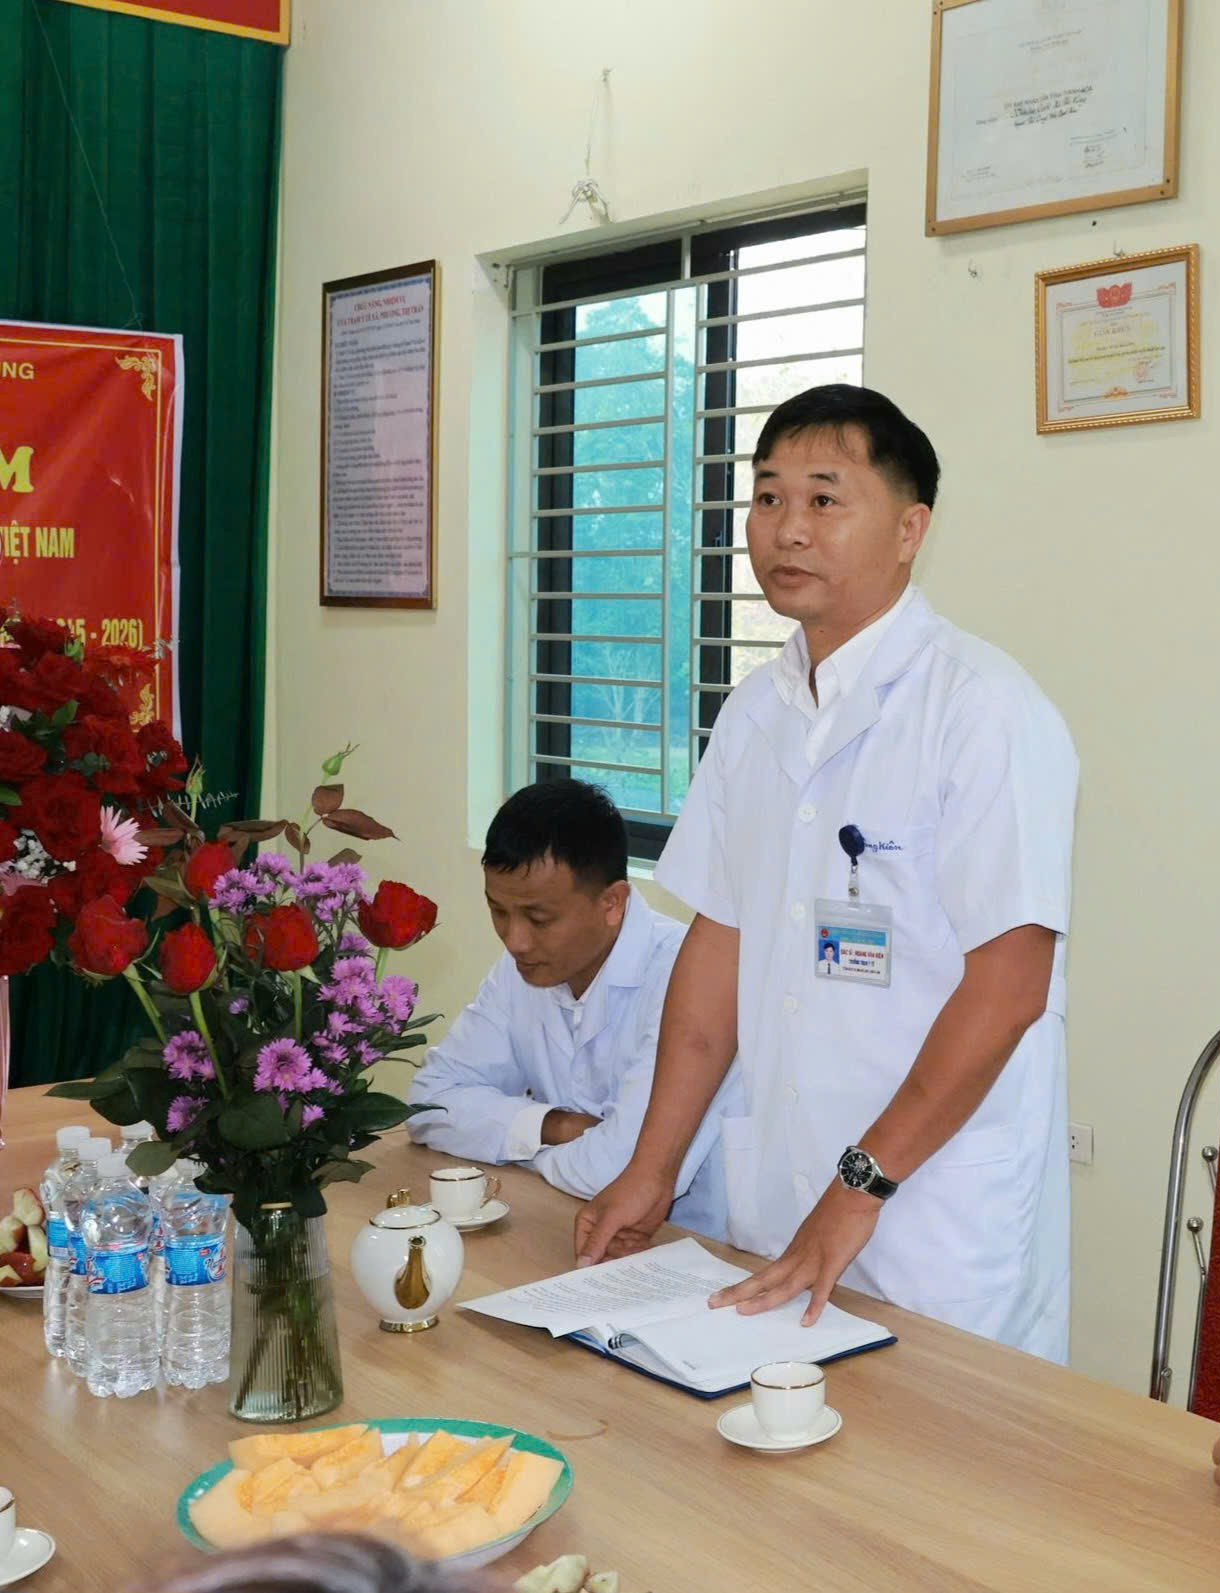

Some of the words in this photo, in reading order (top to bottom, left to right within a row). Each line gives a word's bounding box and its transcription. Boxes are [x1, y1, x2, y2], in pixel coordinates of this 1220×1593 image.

[0, 361, 35, 380] NG
[35, 526, 75, 559] NAM
[101, 618, 144, 651] 2026)
